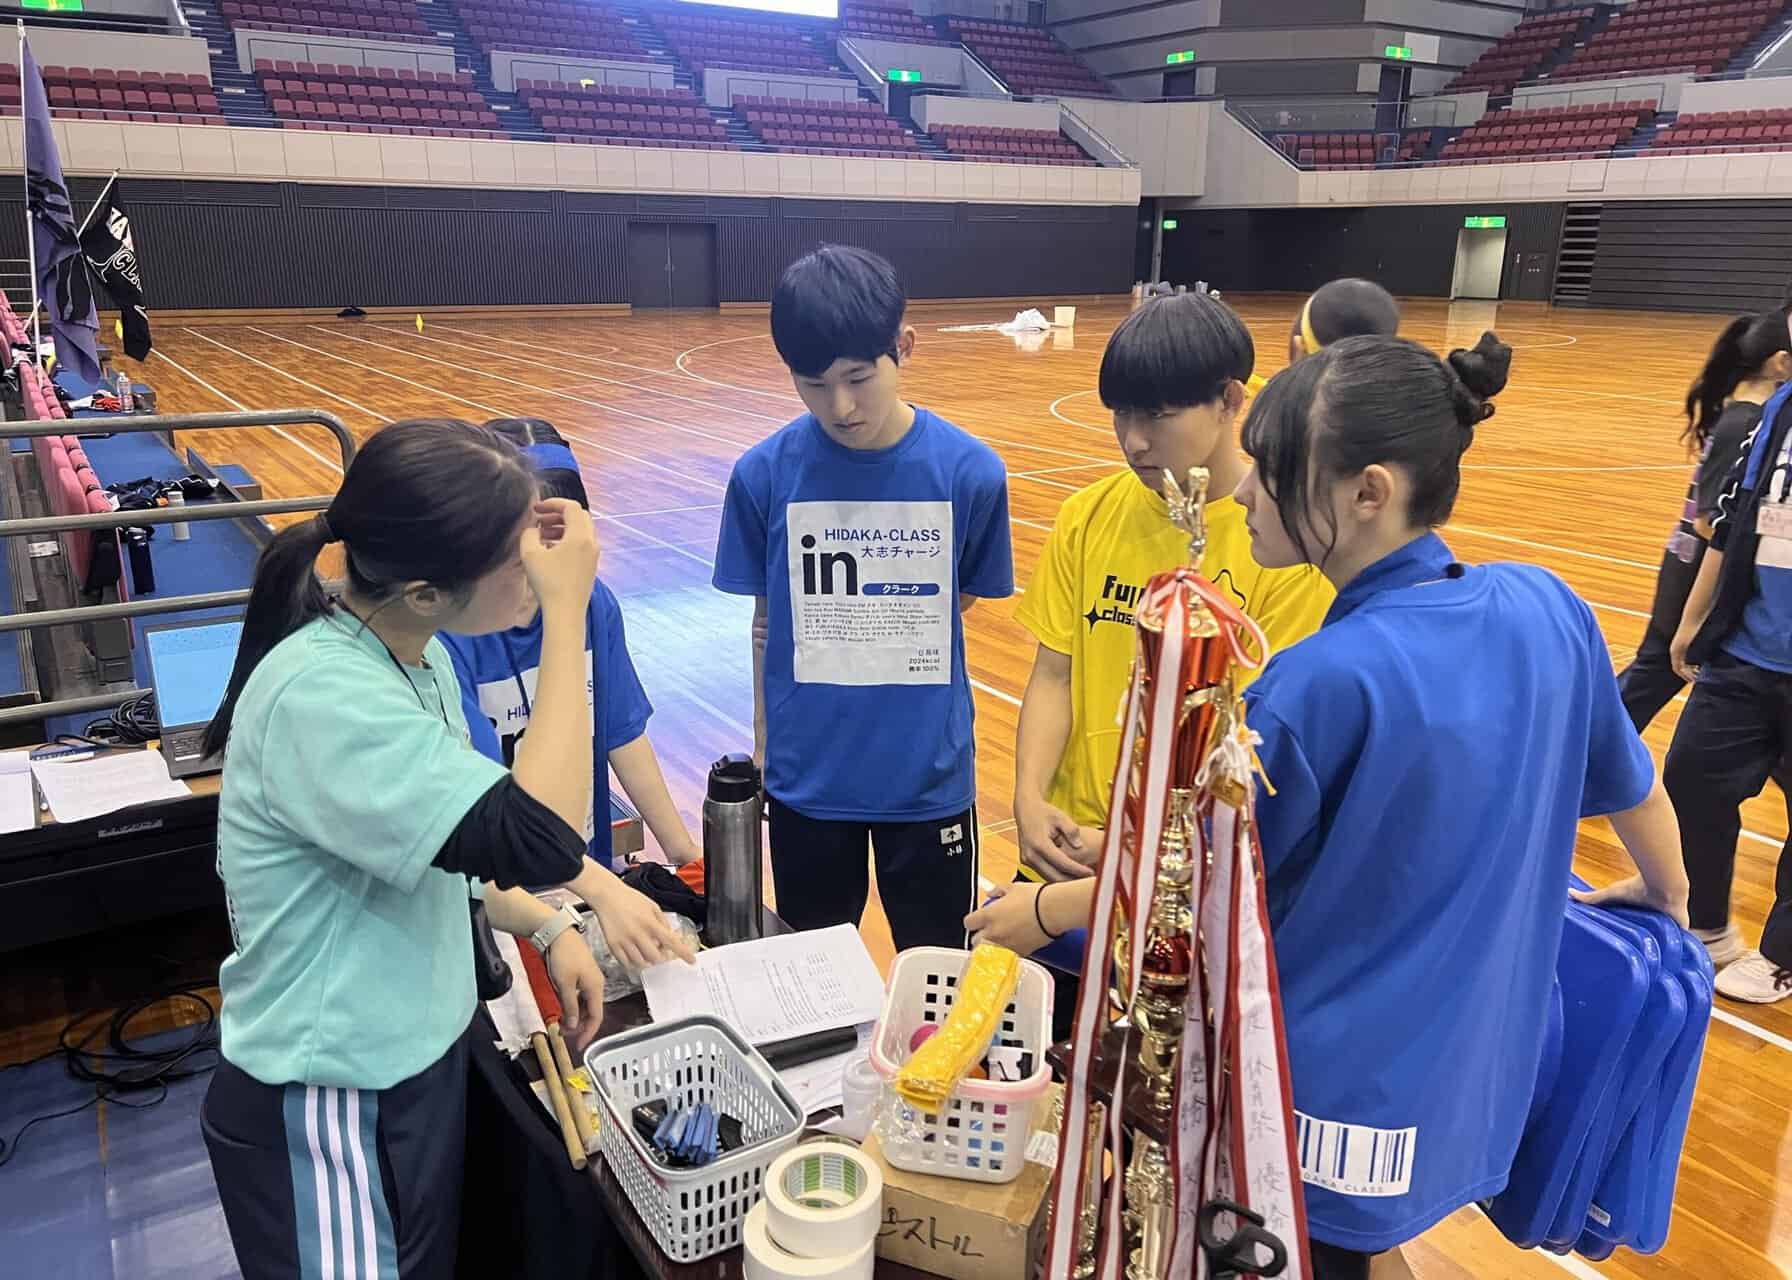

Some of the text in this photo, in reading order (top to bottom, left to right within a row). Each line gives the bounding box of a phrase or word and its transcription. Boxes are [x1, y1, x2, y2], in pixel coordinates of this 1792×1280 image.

[825, 528, 941, 542] HIDAKA-CLASS
[861, 546, 941, 558] 大志チャージ
[801, 534, 858, 596] in
[883, 584, 920, 594] クラーク
